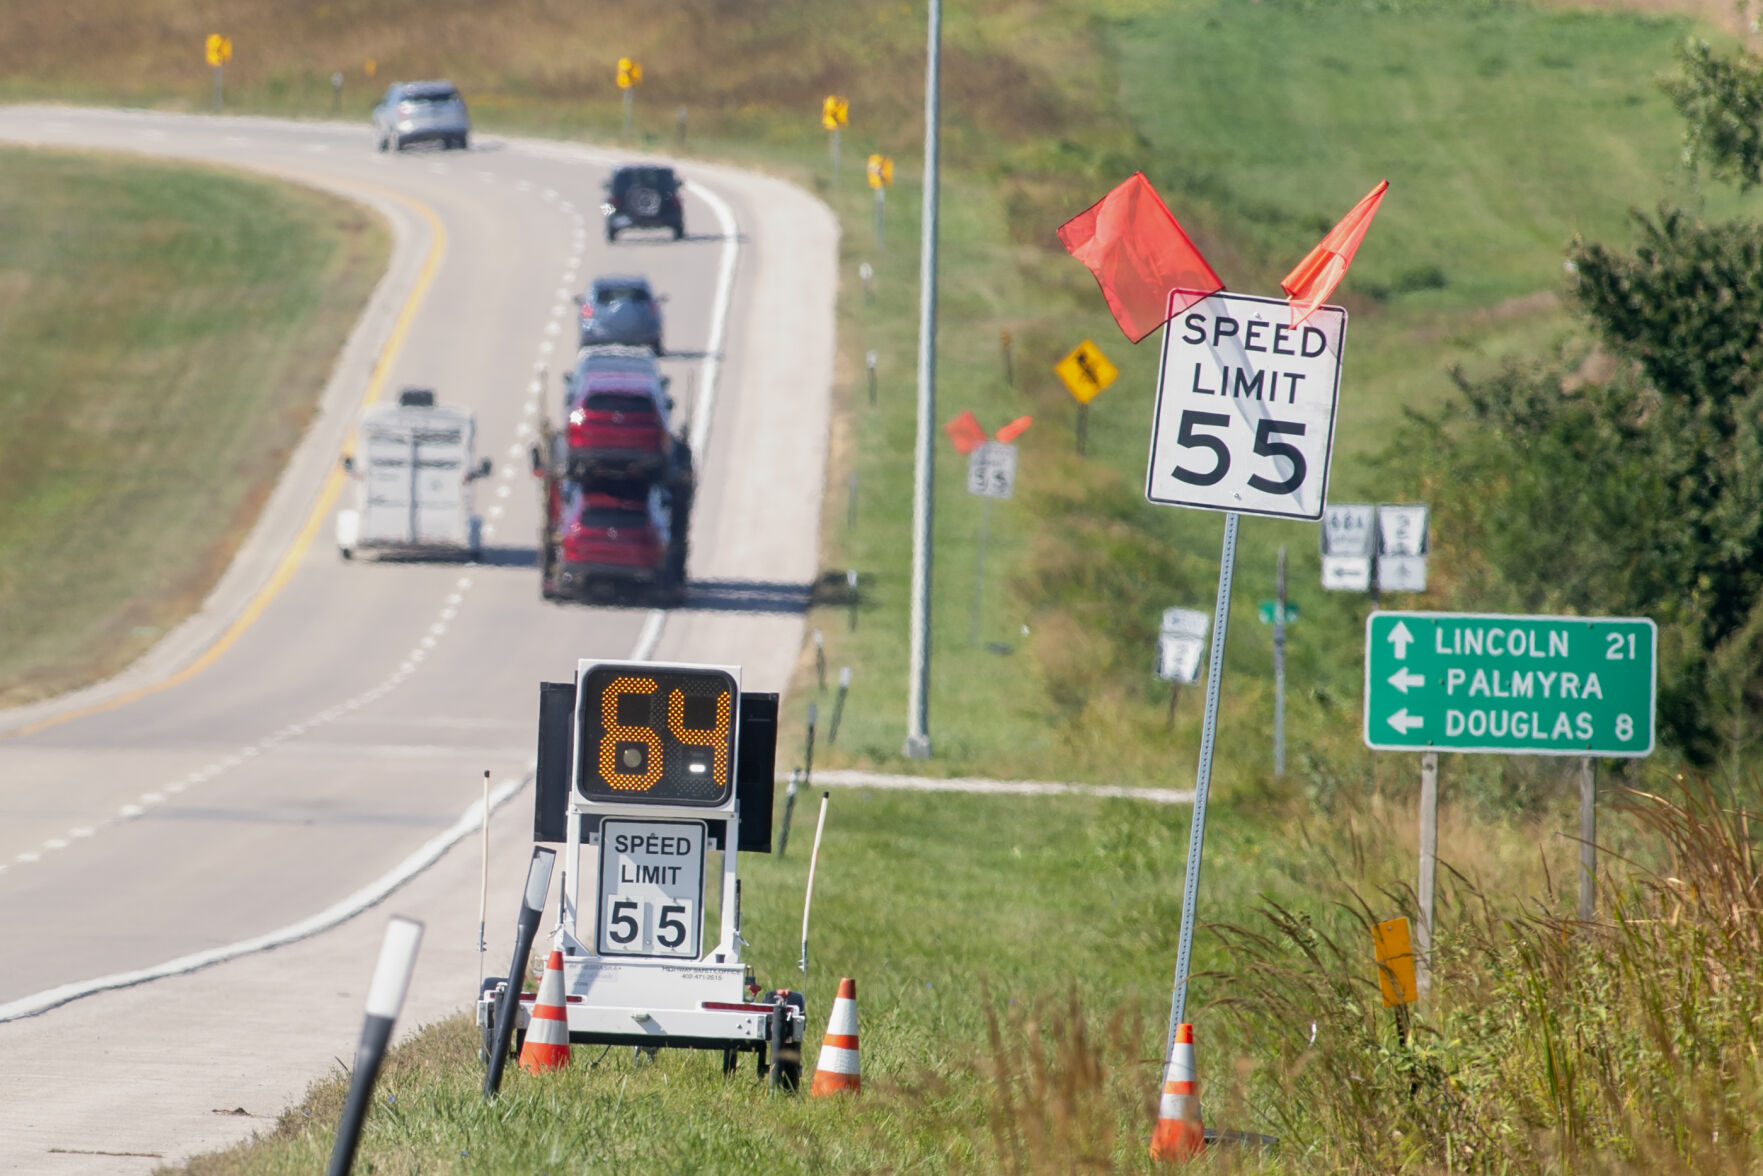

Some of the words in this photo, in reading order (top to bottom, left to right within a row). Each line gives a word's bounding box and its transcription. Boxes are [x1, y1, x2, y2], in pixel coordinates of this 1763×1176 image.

[1182, 313, 1327, 358] SPEED
[1192, 362, 1306, 405] LIMIT
[1171, 409, 1307, 495] 55
[1435, 627, 1569, 658] LINCOLN
[1605, 632, 1636, 660] 21
[1447, 668, 1603, 700] PALMYRA
[598, 676, 731, 791] 64
[1446, 709, 1594, 741] DOUGLAS
[1615, 713, 1634, 742] 8
[614, 834, 692, 856] SPEED
[621, 864, 682, 885] LIMIT
